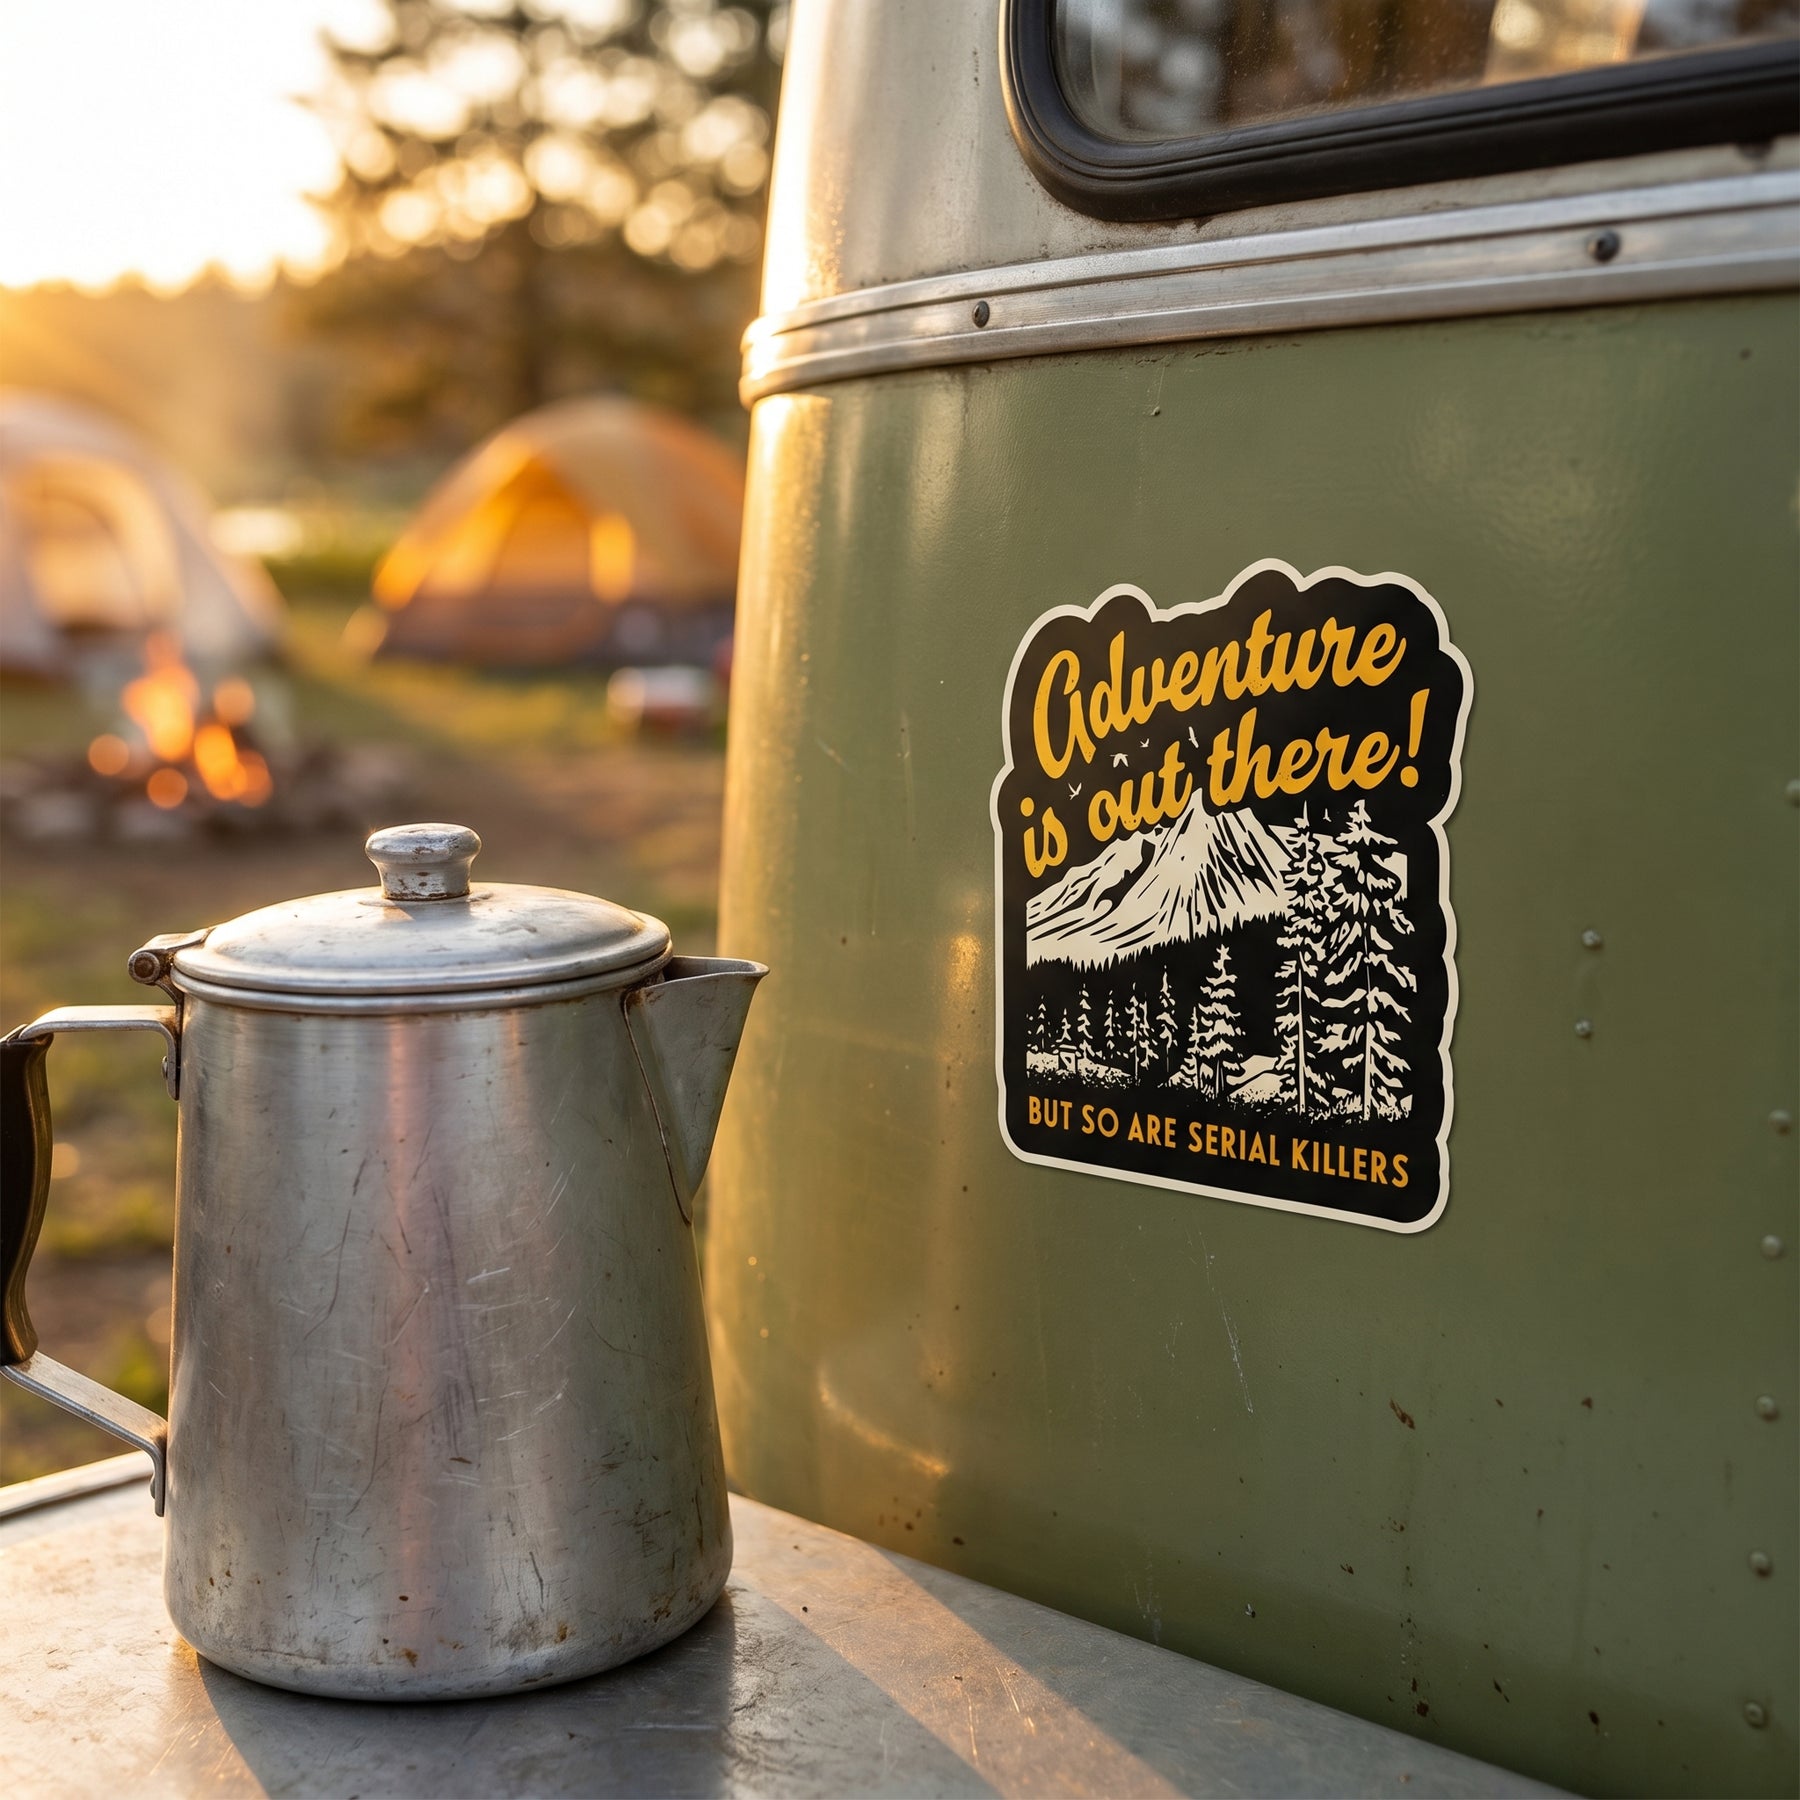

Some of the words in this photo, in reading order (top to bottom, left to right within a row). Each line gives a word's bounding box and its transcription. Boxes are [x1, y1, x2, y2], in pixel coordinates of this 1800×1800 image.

[1032, 608, 1407, 780] Adventure
[1020, 796, 1069, 879] is
[1087, 741, 1194, 842] out
[1206, 688, 1431, 807] there!
[1028, 1095, 1073, 1130] BUT
[1081, 1104, 1120, 1138] SO
[1127, 1113, 1177, 1149] ARE
[1188, 1121, 1281, 1167] SERIAL
[1291, 1138, 1410, 1188] KILLERS
